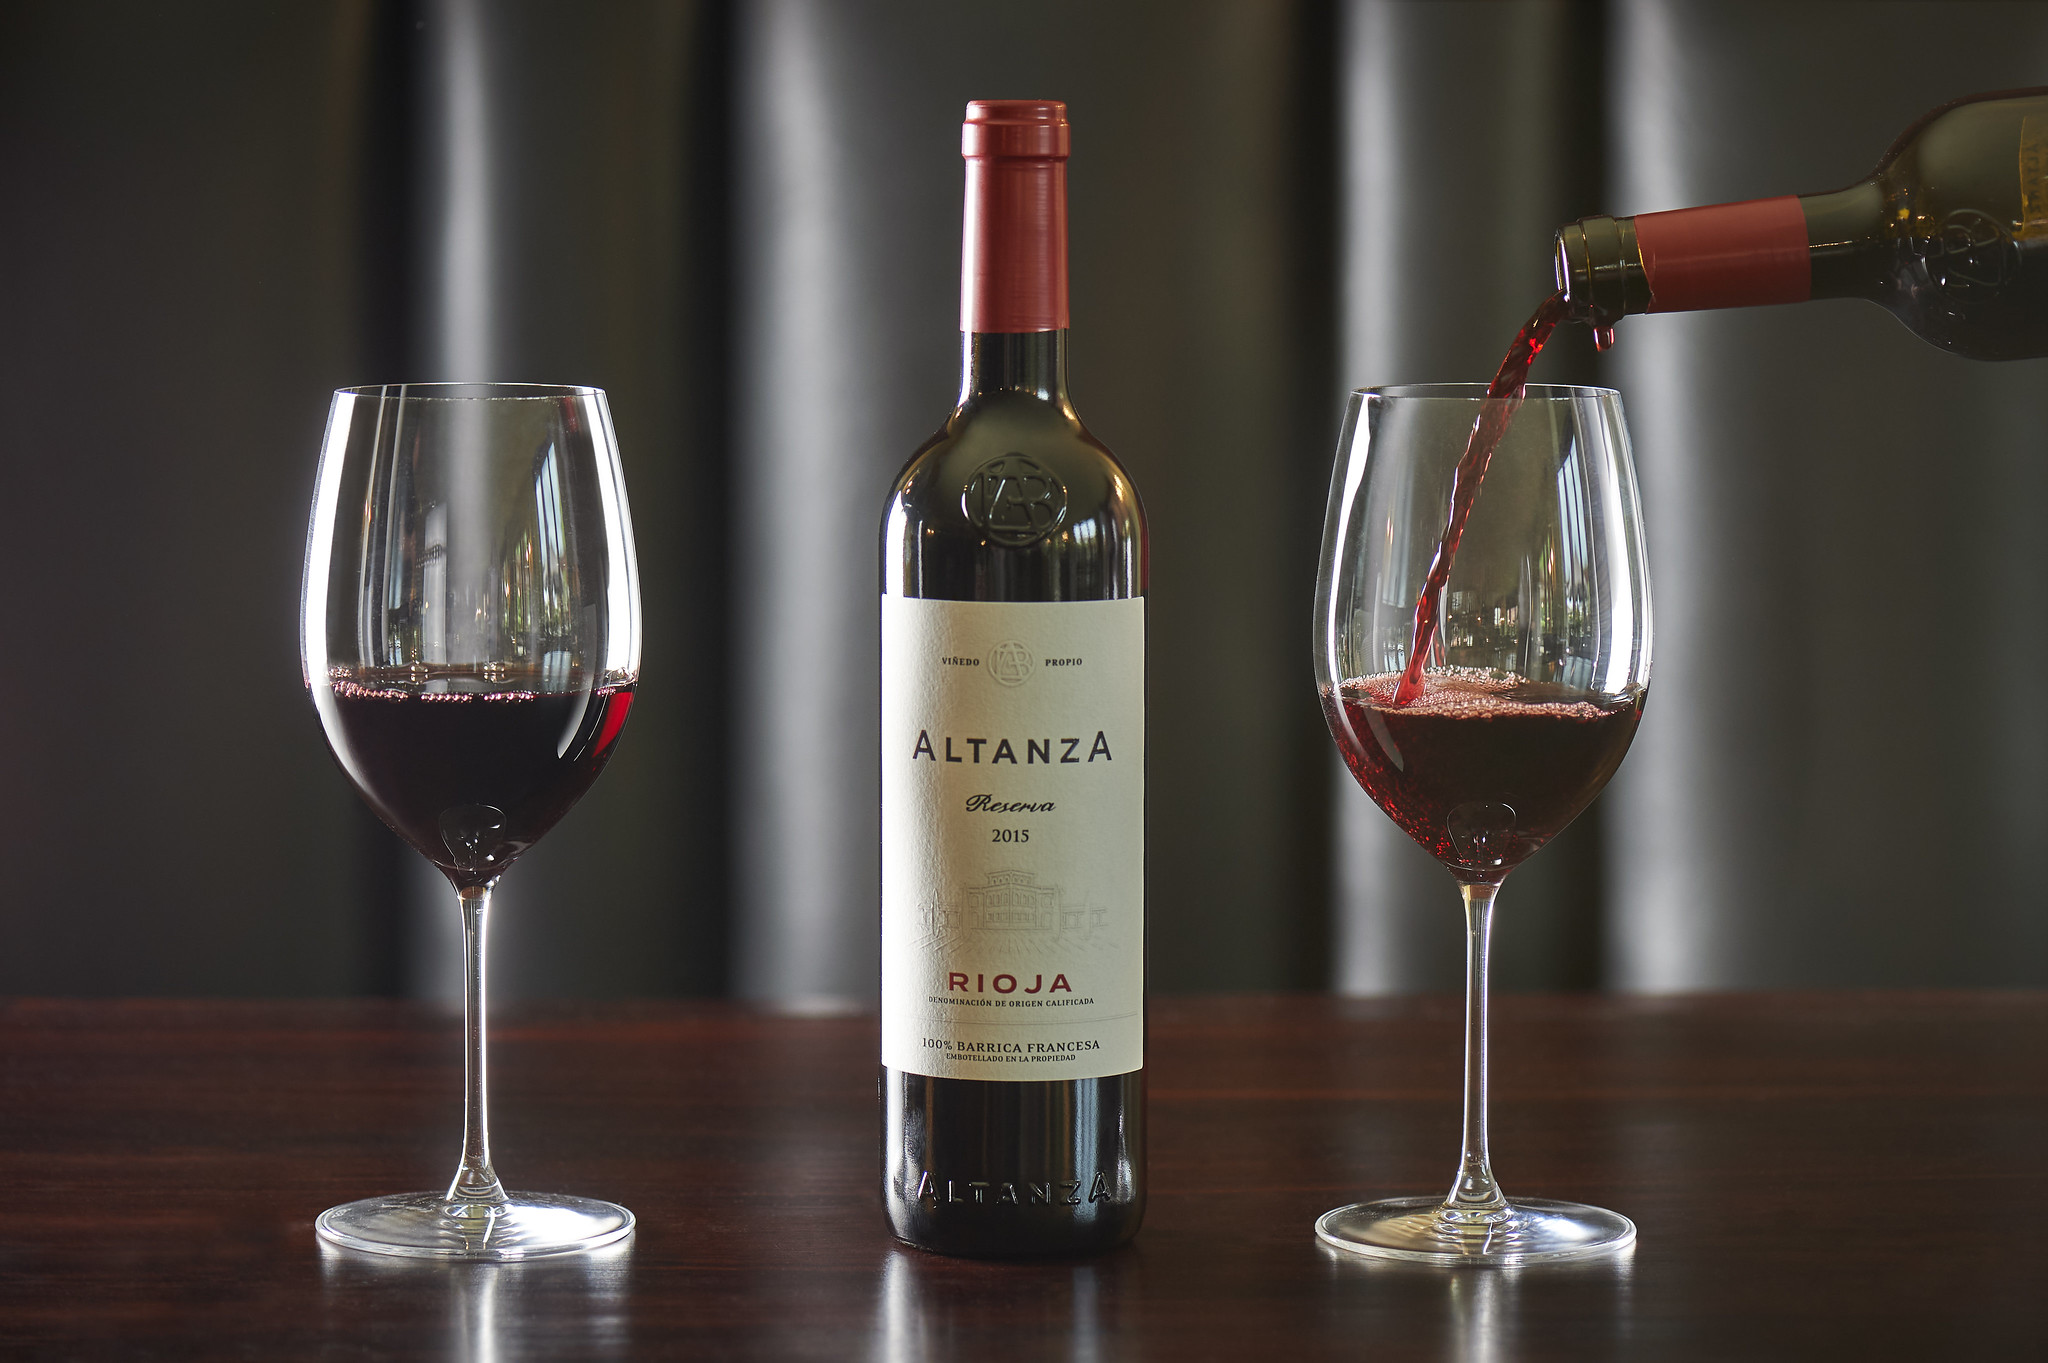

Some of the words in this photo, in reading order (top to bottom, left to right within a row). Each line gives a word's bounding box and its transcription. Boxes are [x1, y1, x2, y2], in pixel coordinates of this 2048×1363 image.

[941, 656, 980, 667] VIÑEDO
[1045, 658, 1083, 667] PROPIO
[912, 729, 1113, 765] ALTANZA
[965, 794, 1057, 813] Reserva
[991, 829, 1030, 843] 2015
[948, 972, 1073, 994] RIOJA
[928, 996, 992, 1007] DENOMINACIÓN
[995, 1000, 1007, 1008] DE
[1009, 1000, 1043, 1008] ORIGEN
[1046, 998, 1095, 1007] CALIFICADA
[922, 1038, 953, 1050] 100%
[957, 1041, 1022, 1053] BARRICA
[1027, 1040, 1101, 1053] FRANCESA
[946, 1053, 1004, 1063] EMBOTELLADO
[1031, 1054, 1076, 1063] PROPIEDAD
[918, 1171, 1112, 1206] ALTANZA
